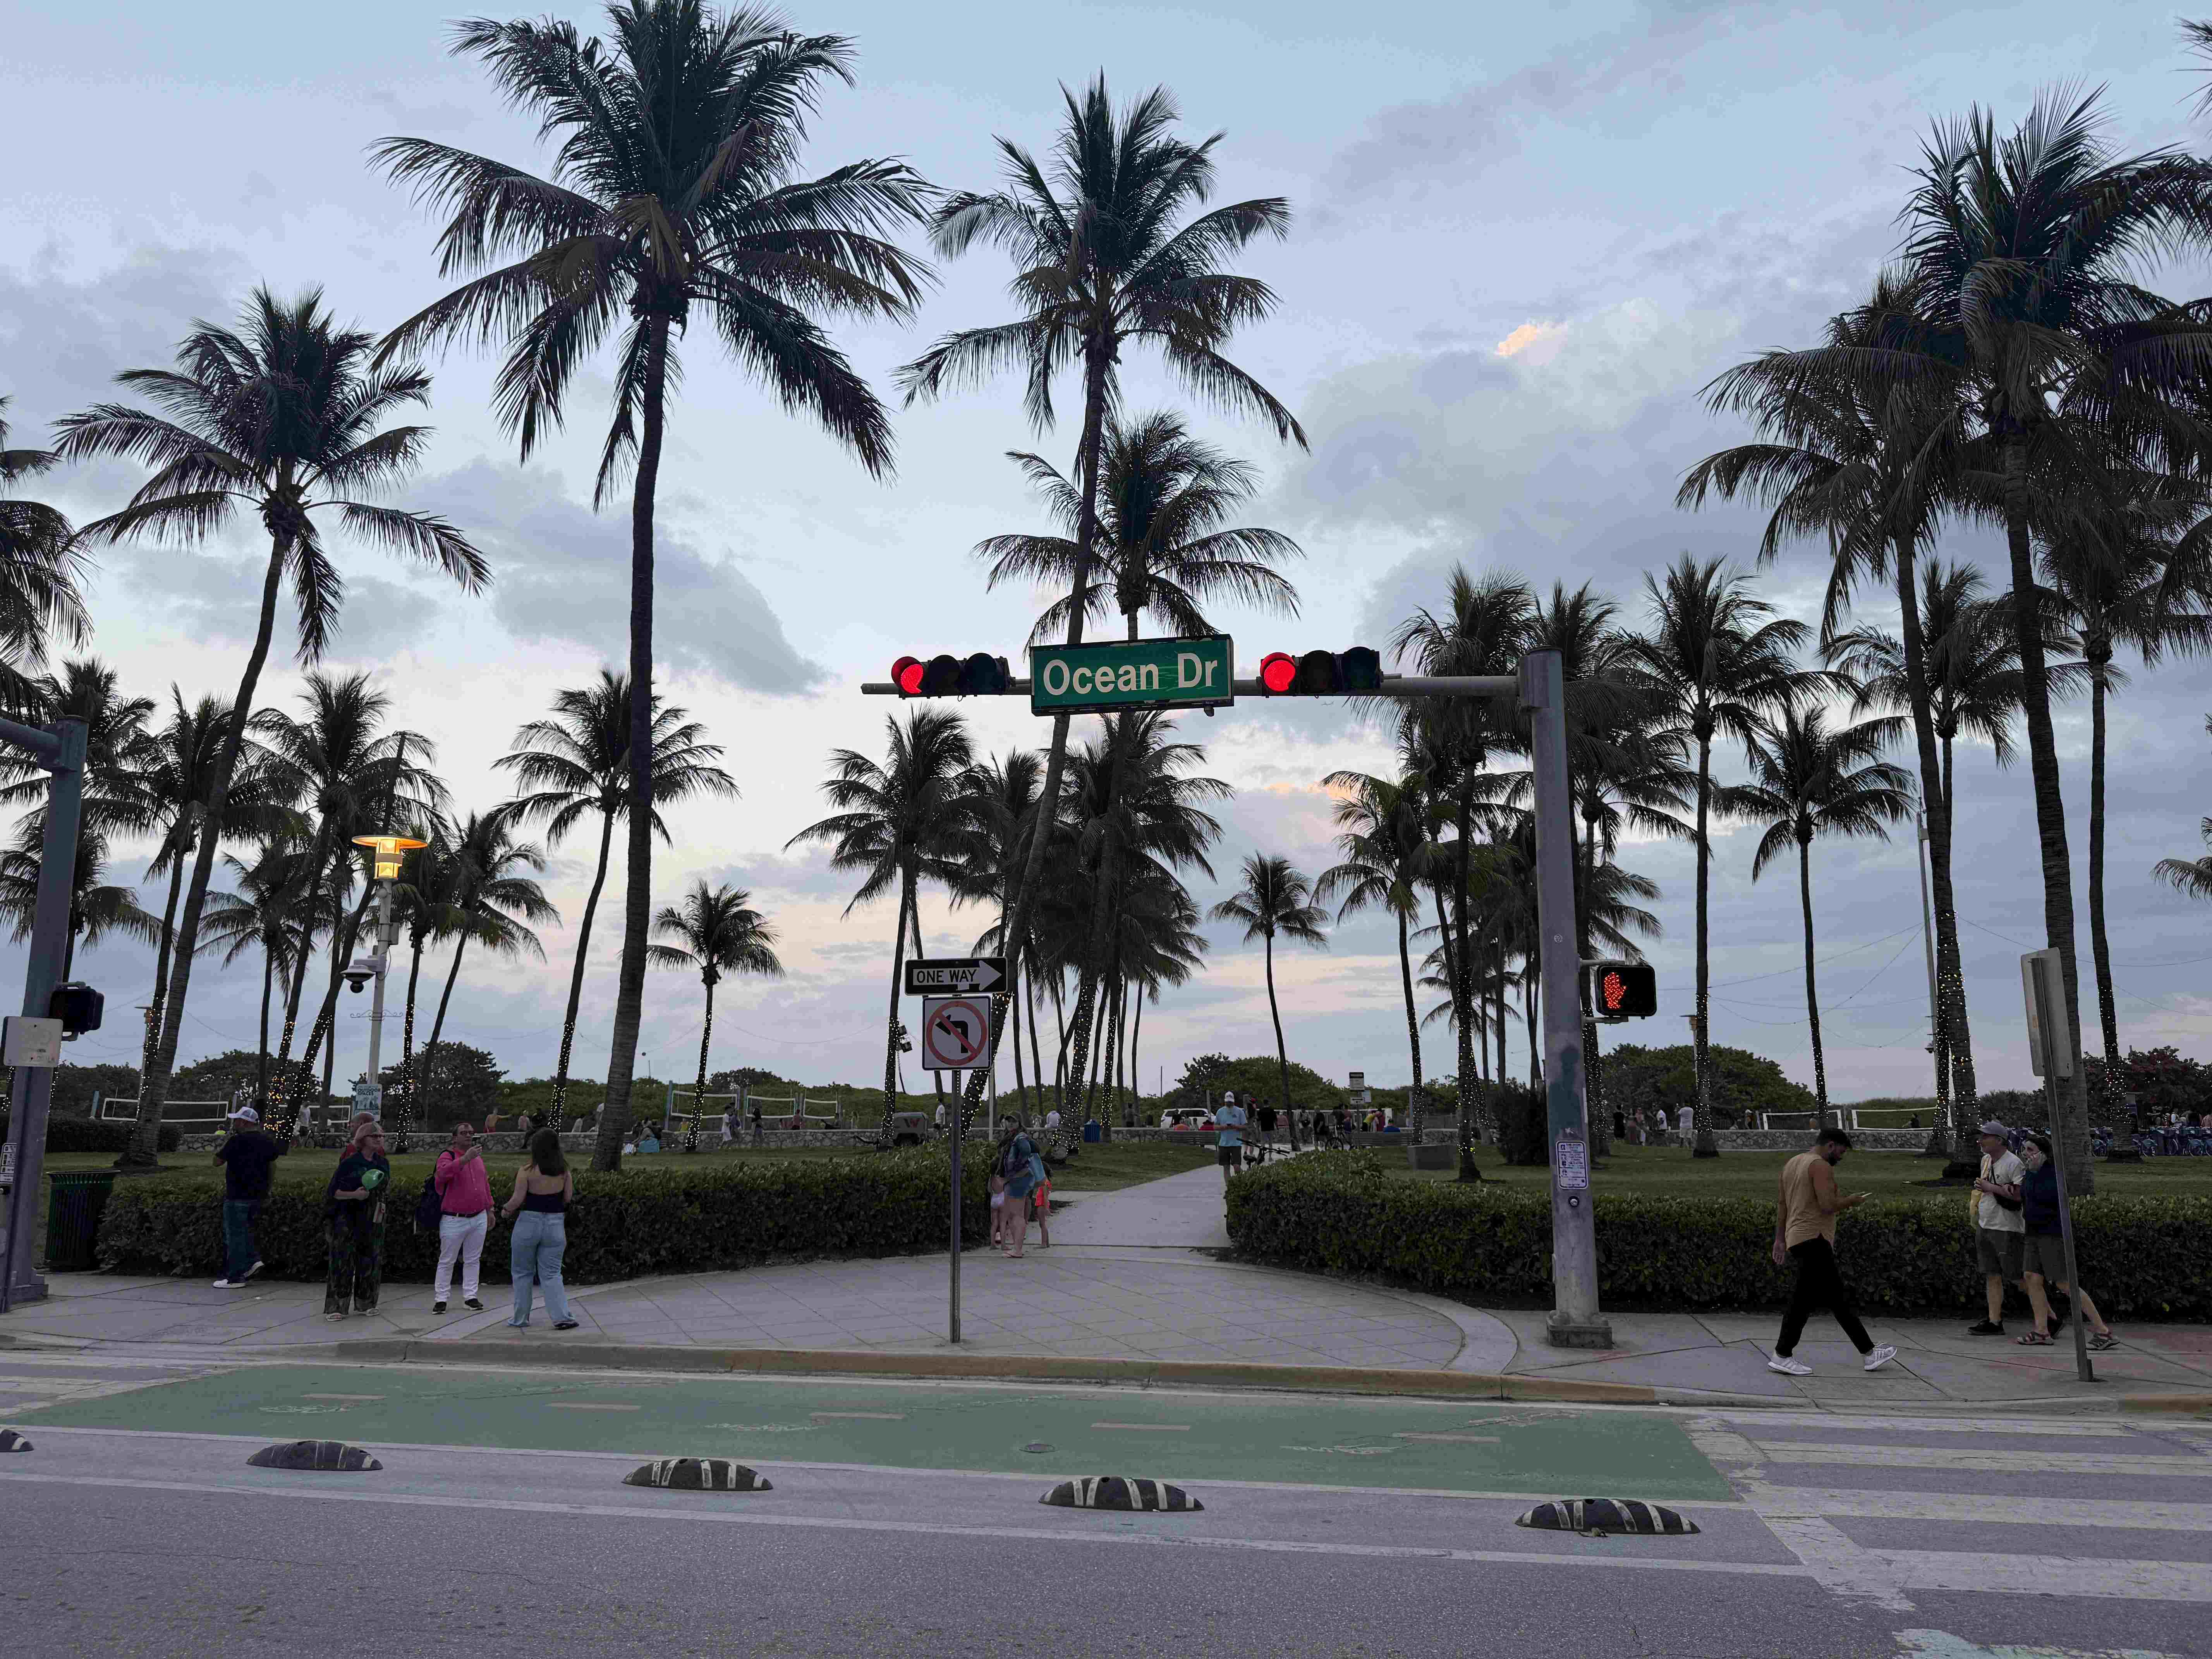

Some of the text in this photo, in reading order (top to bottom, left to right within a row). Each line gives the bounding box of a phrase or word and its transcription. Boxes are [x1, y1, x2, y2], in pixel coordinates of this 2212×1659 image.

[1043, 653, 1218, 695] Ocean Dr
[916, 969, 977, 983] ONE WAY
